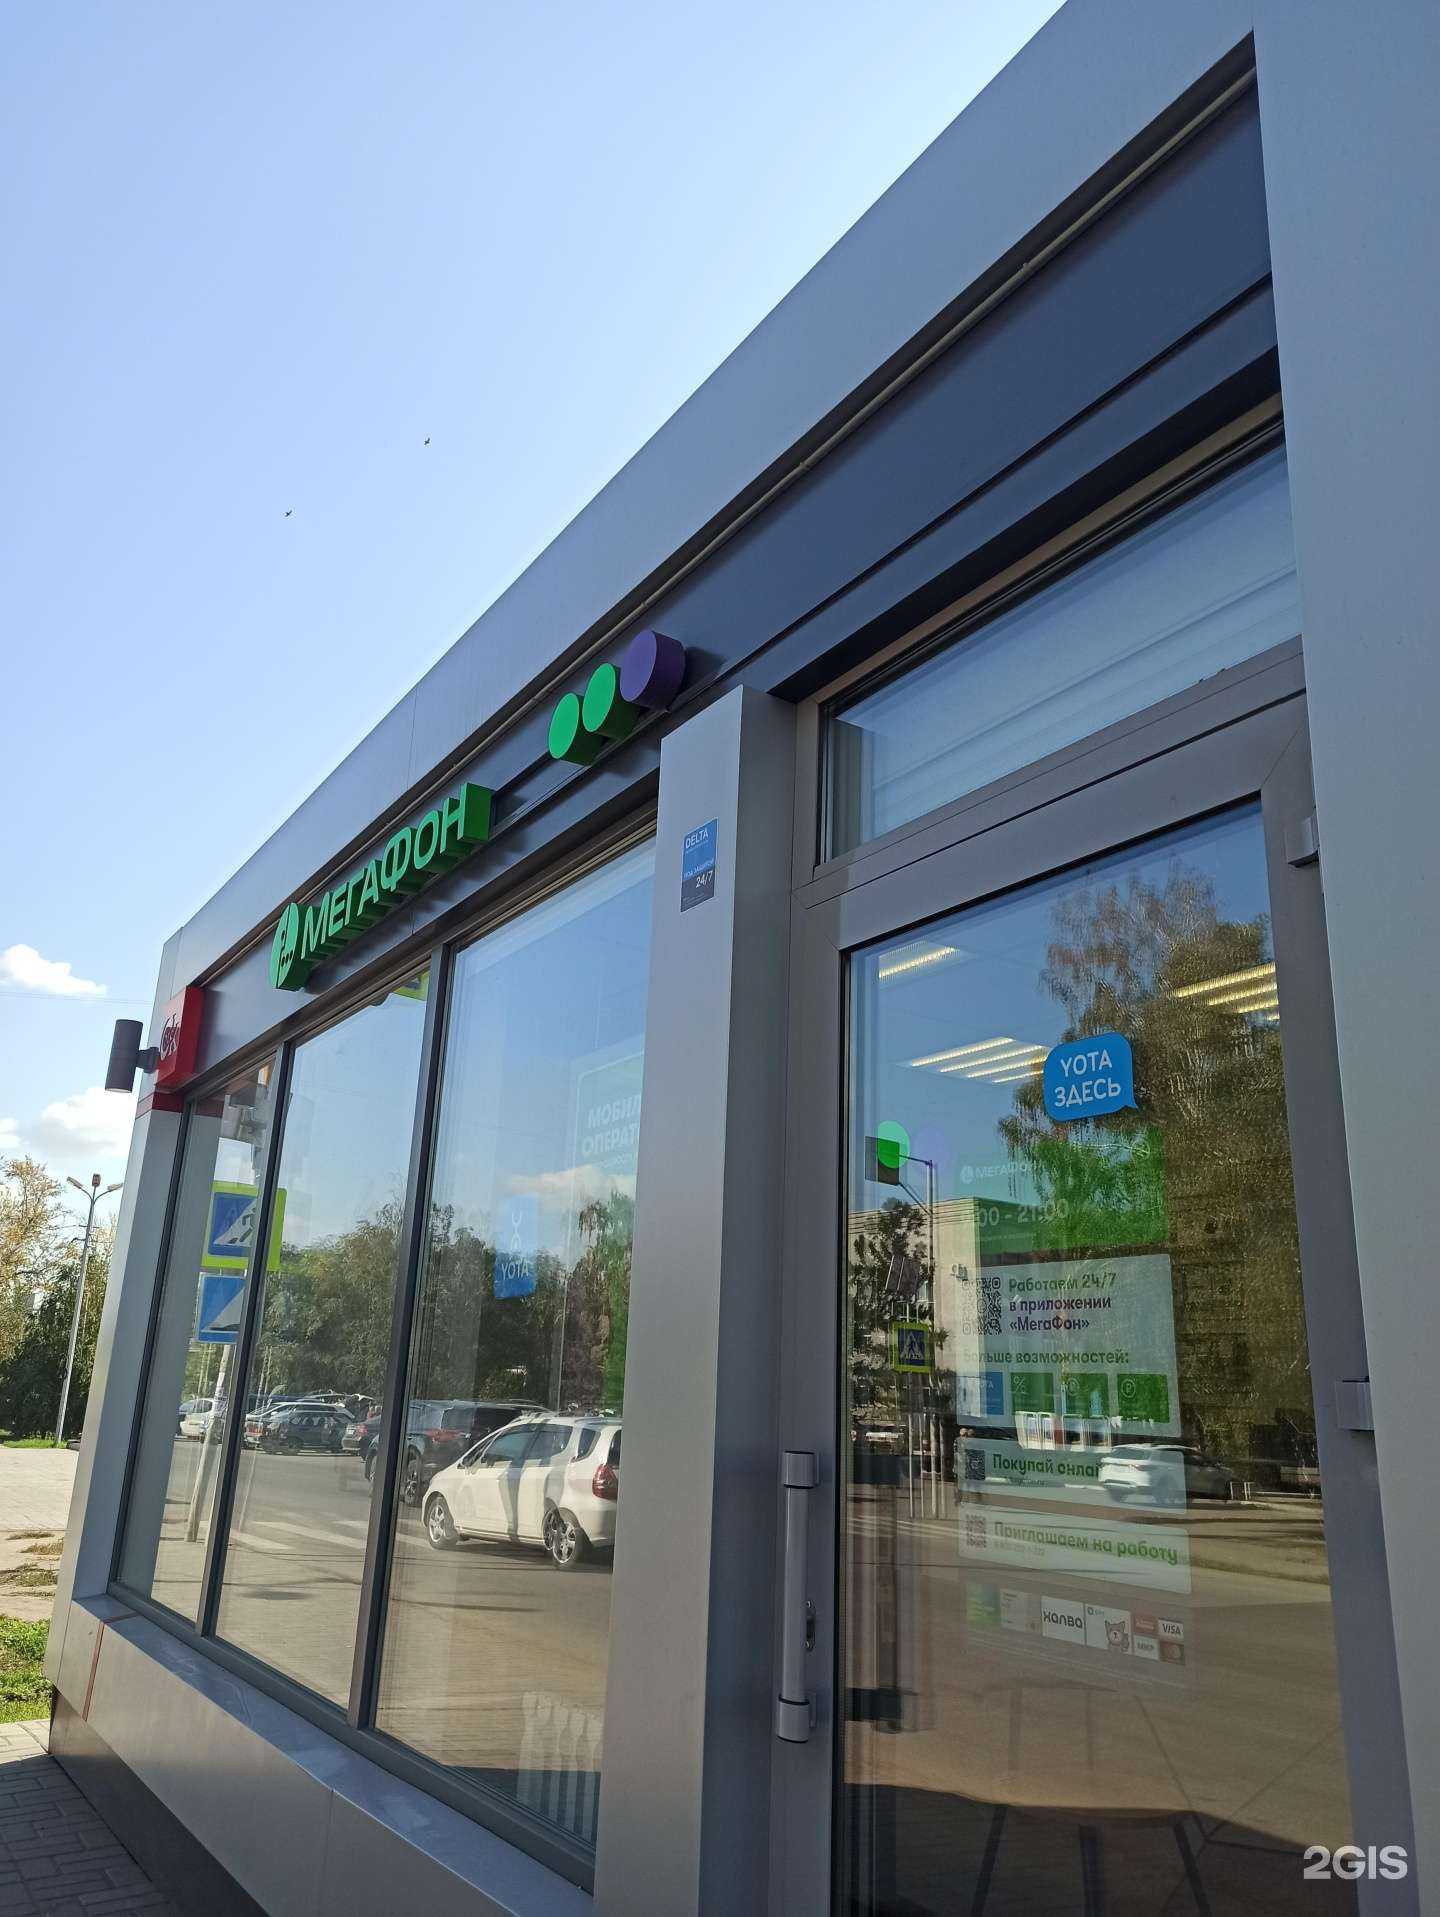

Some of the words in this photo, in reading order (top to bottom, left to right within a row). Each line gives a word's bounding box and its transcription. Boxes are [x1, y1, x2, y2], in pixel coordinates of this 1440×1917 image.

[685, 827, 709, 849] DELTA
[301, 783, 468, 960] МЕГАФОН
[695, 870, 714, 888] 24/7
[1060, 1049, 1112, 1077] YOTA
[1054, 1078, 1121, 1107] ЗДЕСЬ
[501, 1260, 529, 1281] YOTA
[1008, 1277, 1079, 1293] Работаем
[1082, 1272, 1117, 1289] 24/7
[1009, 1302, 1017, 1312] в
[1020, 1297, 1112, 1315] приложении
[1009, 1315, 1091, 1331] «МегаФон»
[1016, 1349, 1130, 1364] возможностей:
[993, 1453, 1054, 1477] Покупай
[994, 1521, 1089, 1551] Приглашаем
[1093, 1536, 1112, 1552] на
[1117, 1540, 1179, 1565] работу
[1162, 1623, 1182, 1635] VISA
